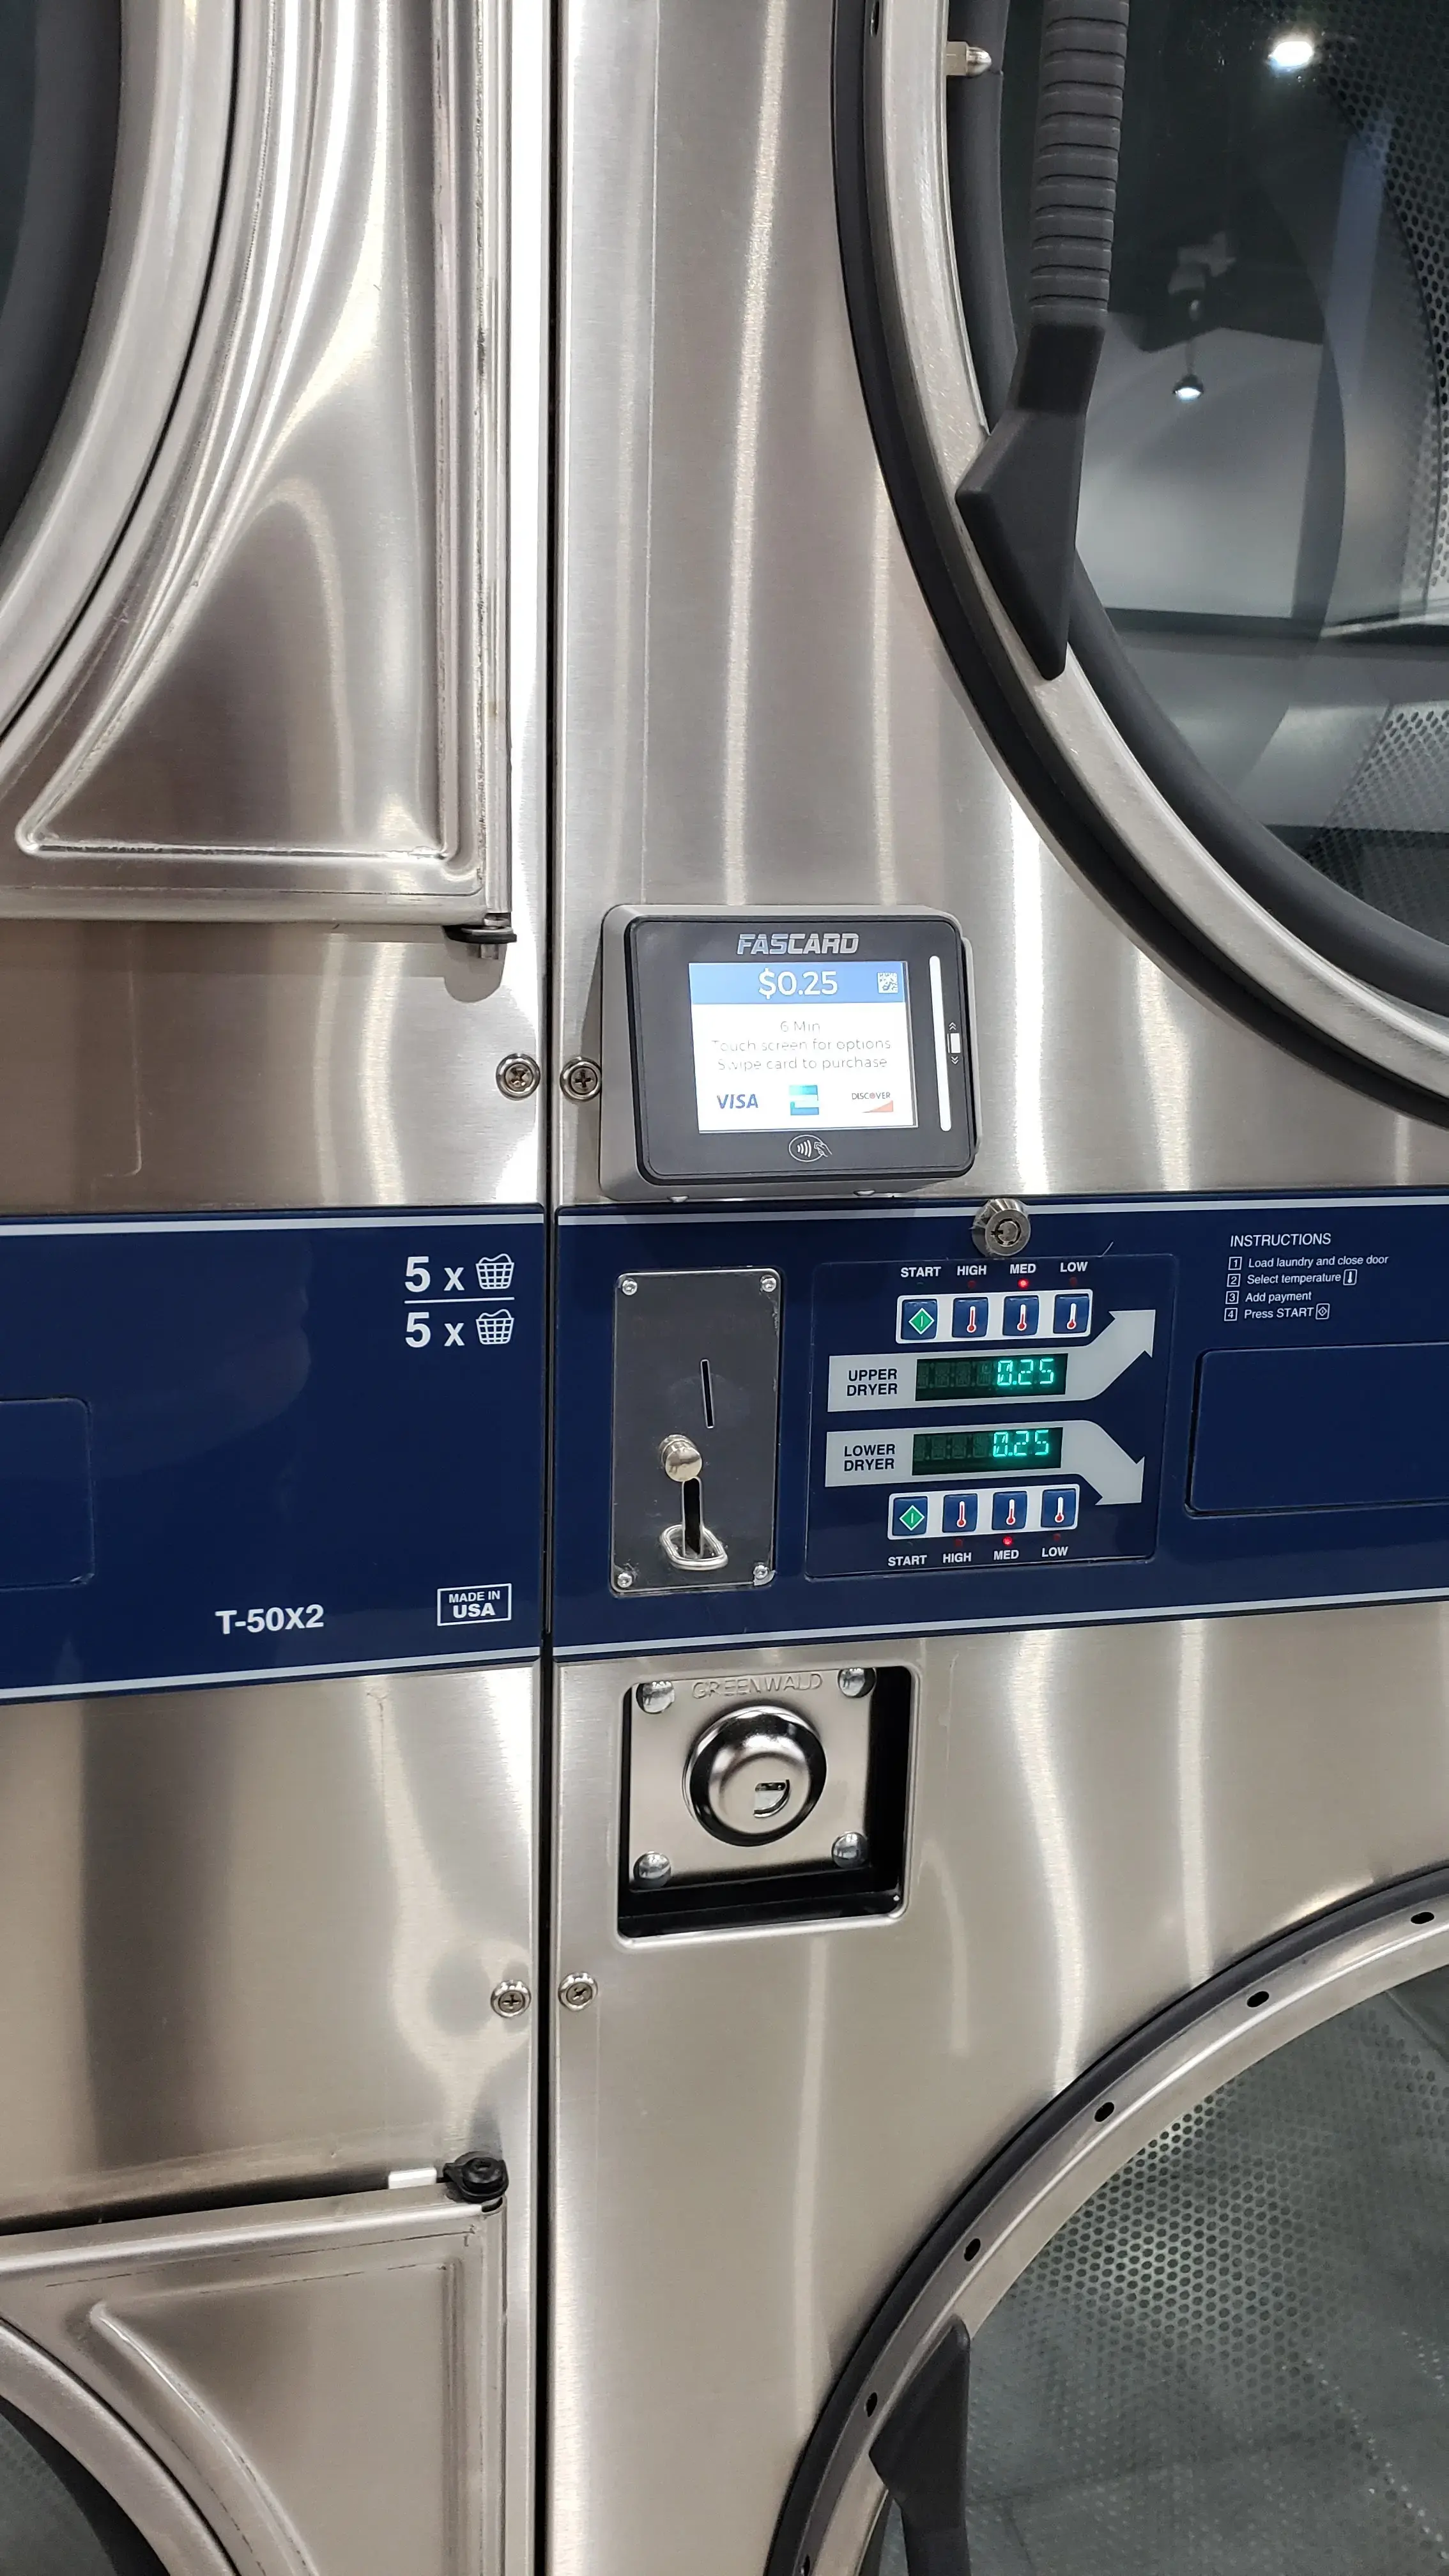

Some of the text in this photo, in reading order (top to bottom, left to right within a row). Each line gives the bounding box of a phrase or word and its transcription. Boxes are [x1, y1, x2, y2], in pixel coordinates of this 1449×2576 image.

[737, 933, 859, 955] FASCARD
[758, 968, 838, 999] $0.25
[780, 1021, 820, 1032] 6 Min
[762, 1041, 807, 1052] screen
[813, 1038, 832, 1050] for
[767, 1057, 797, 1070] card
[802, 1058, 817, 1069] to
[822, 1056, 887, 1071] purchase
[716, 1093, 759, 1109] VISA
[851, 1092, 891, 1100] DISCOVER
[1230, 1232, 1331, 1248] INSTRUCTIONS
[900, 1261, 1088, 1278] START HIGH MED LOW
[1248, 1258, 1274, 1268] Load
[1276, 1257, 1314, 1269] laundry
[1316, 1256, 1335, 1266] and
[1338, 1255, 1364, 1266] close
[1366, 1255, 1390, 1264] door
[404, 1255, 431, 1292] 5
[1246, 1275, 1278, 1285] Select
[1281, 1273, 1341, 1286] temperature
[1245, 1292, 1266, 1303] Add
[1268, 1291, 1312, 1304] payment
[1244, 1309, 1273, 1319] Press
[1276, 1307, 1314, 1318] START
[404, 1312, 431, 1349] 5
[848, 1368, 898, 1382] UPPER
[997, 1358, 1055, 1386] 0.25
[847, 1383, 898, 1397] DRYER
[843, 1443, 895, 1457] LOWER
[992, 1429, 1050, 1458] 0.25
[843, 1458, 894, 1471] DRYER
[887, 1545, 1068, 1567] START HIGH MED LOW
[448, 1590, 501, 1604] MADE IN
[452, 1602, 496, 1619] USA
[214, 1604, 325, 1635] T-50X2
[691, 1673, 823, 1699] GREENWALD
